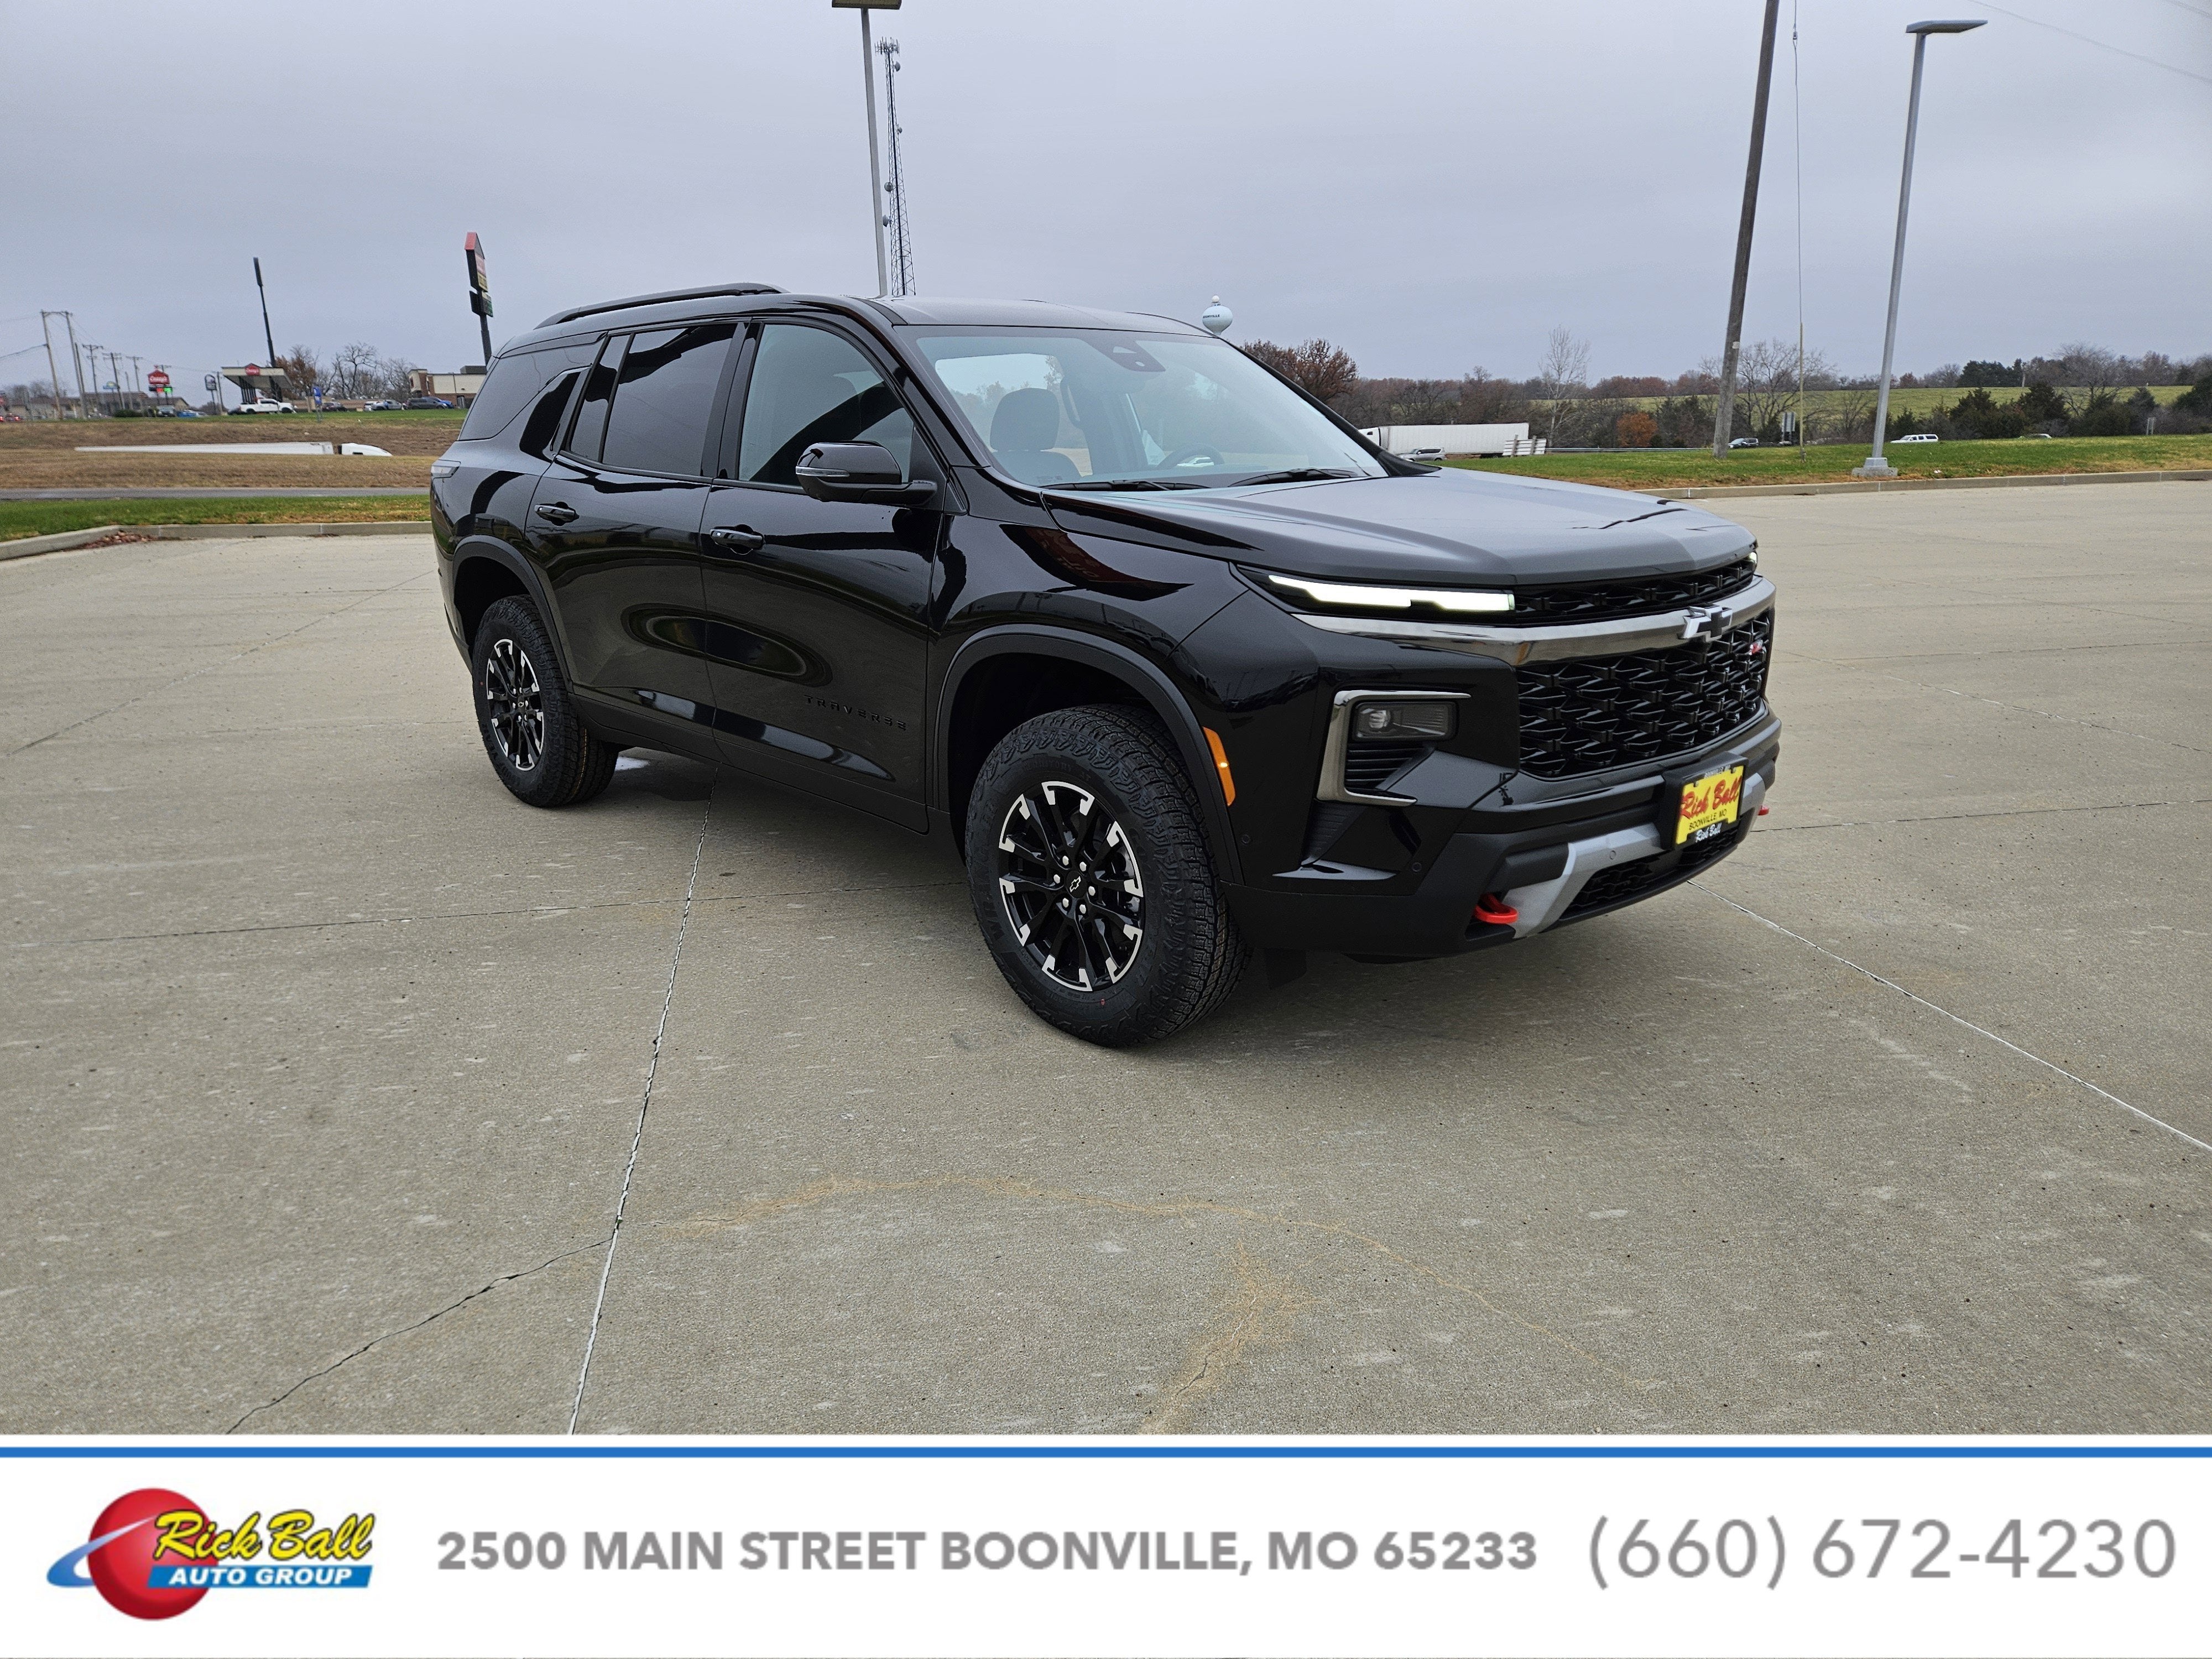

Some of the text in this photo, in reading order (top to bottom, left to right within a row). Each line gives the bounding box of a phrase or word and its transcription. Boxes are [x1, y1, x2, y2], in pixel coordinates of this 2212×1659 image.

[804, 695, 907, 731] TRAVERSE
[1680, 775, 1743, 820] Rick Ball
[1719, 808, 1727, 818] MO
[1709, 822, 1722, 837] Ball
